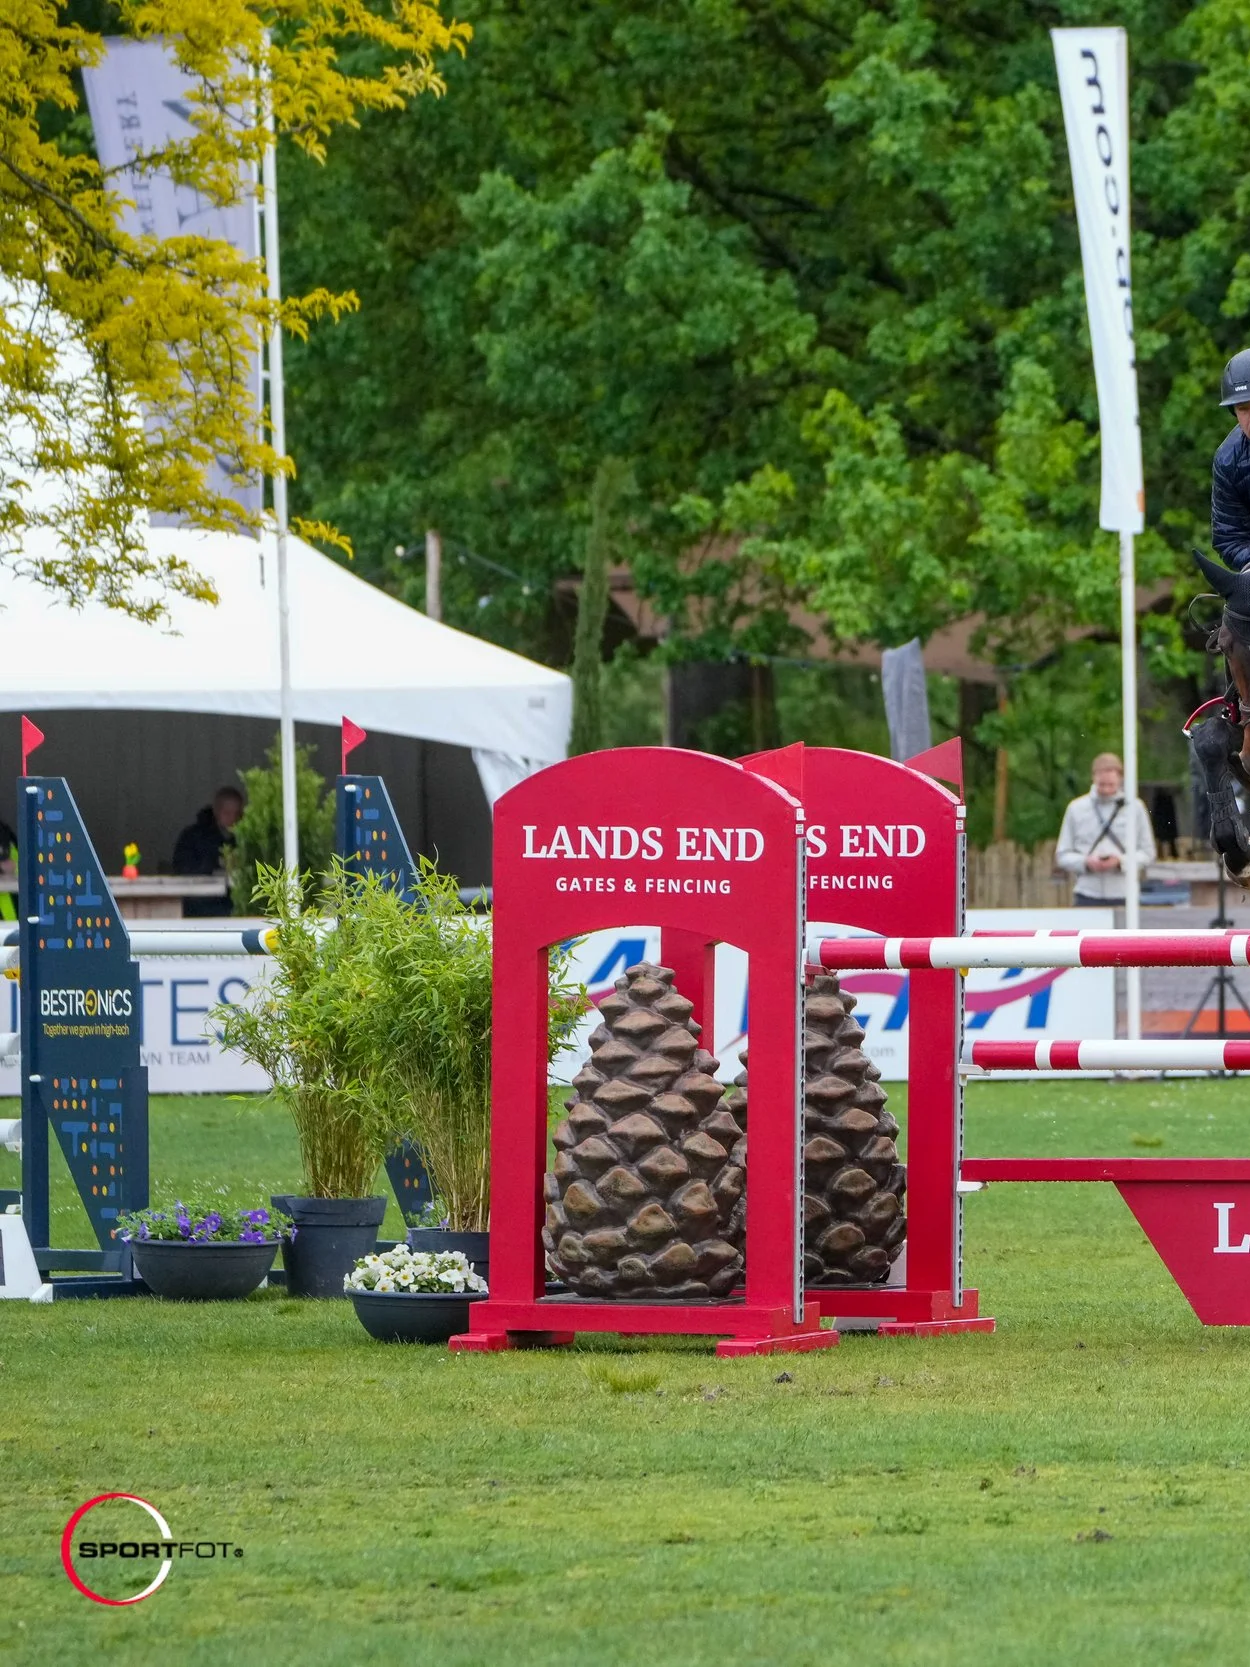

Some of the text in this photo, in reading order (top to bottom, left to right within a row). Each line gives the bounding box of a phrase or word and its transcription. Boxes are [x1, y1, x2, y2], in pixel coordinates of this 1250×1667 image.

[522, 825, 664, 860] LANDS
[676, 827, 765, 862] END
[839, 824, 926, 858] END
[555, 876, 731, 895] GATES & FENCING
[809, 875, 893, 890] FENCING
[42, 1023, 69, 1038] Together
[69, 1026, 79, 1035] we
[79, 1026, 95, 1038] grow
[100, 1023, 130, 1038] high-tech
[168, 1051, 210, 1064] TEAM
